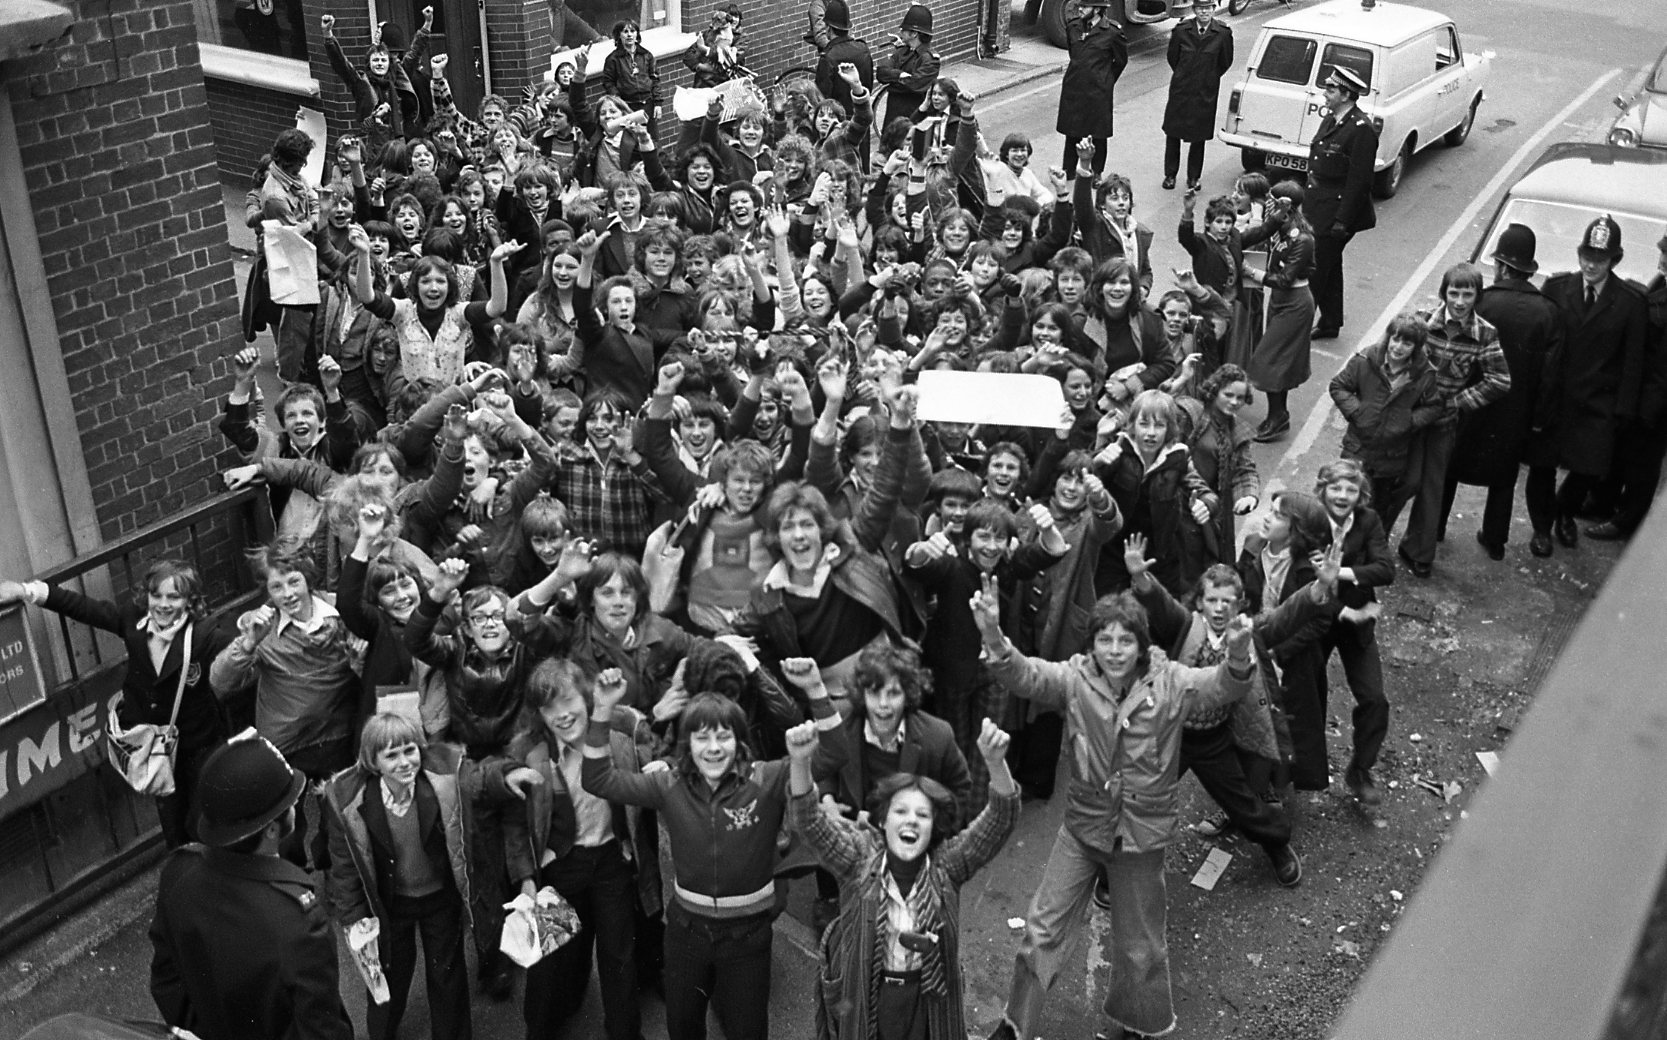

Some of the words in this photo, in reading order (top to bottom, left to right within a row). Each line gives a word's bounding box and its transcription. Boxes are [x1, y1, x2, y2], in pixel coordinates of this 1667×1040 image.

[1444, 77, 1460, 95] POLICE
[1266, 152, 1290, 167] KPO
[1290, 158, 1308, 170] 58
[1, 639, 23, 660] LTD
[0, 664, 24, 685] ORS
